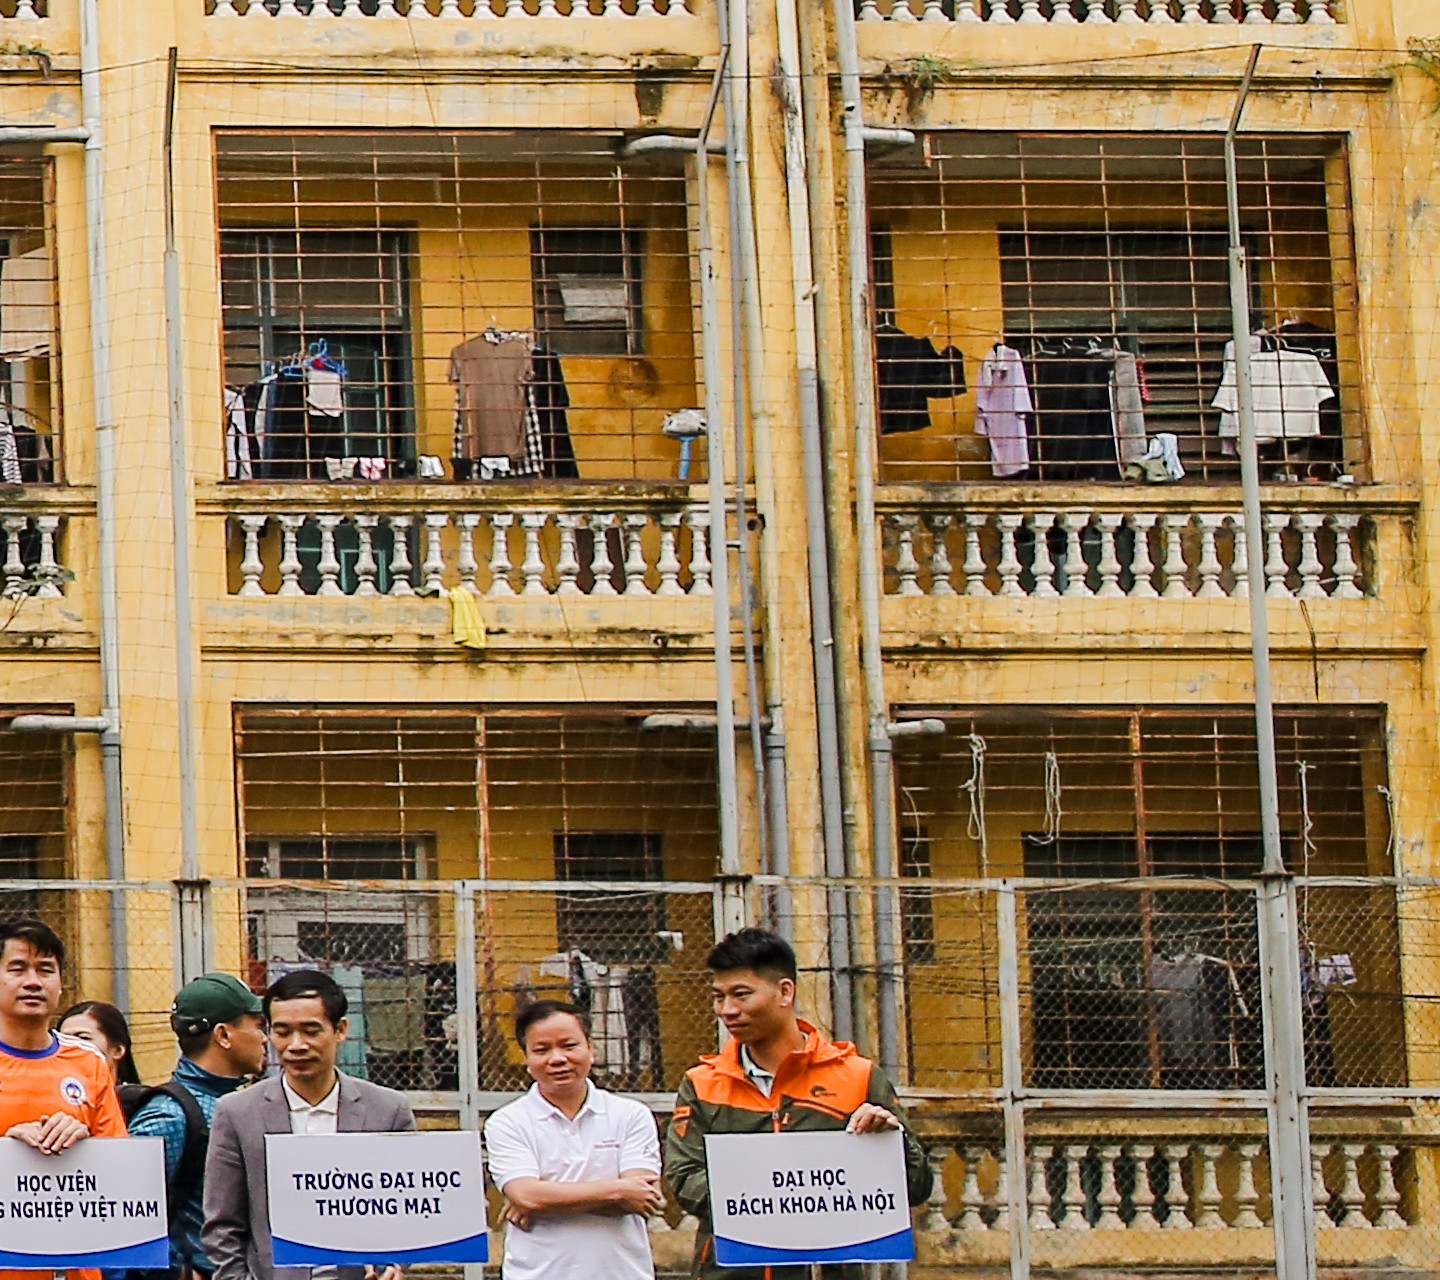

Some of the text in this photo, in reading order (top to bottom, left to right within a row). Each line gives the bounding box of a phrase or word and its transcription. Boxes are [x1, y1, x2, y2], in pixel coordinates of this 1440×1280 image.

[17, 1169, 96, 1196] HỌC VIỆN
[293, 1168, 461, 1192] TRƯỜNG ĐẠI HỌC
[773, 1169, 846, 1191] ĐẠI HỌC
[11, 1196, 74, 1222] NGHIỆP
[79, 1196, 117, 1221] VIỆT
[123, 1201, 158, 1217] NAM
[316, 1196, 441, 1218] THƯƠNG MẠI
[727, 1188, 895, 1215] BÁCH KHOA HÀ NỘI
